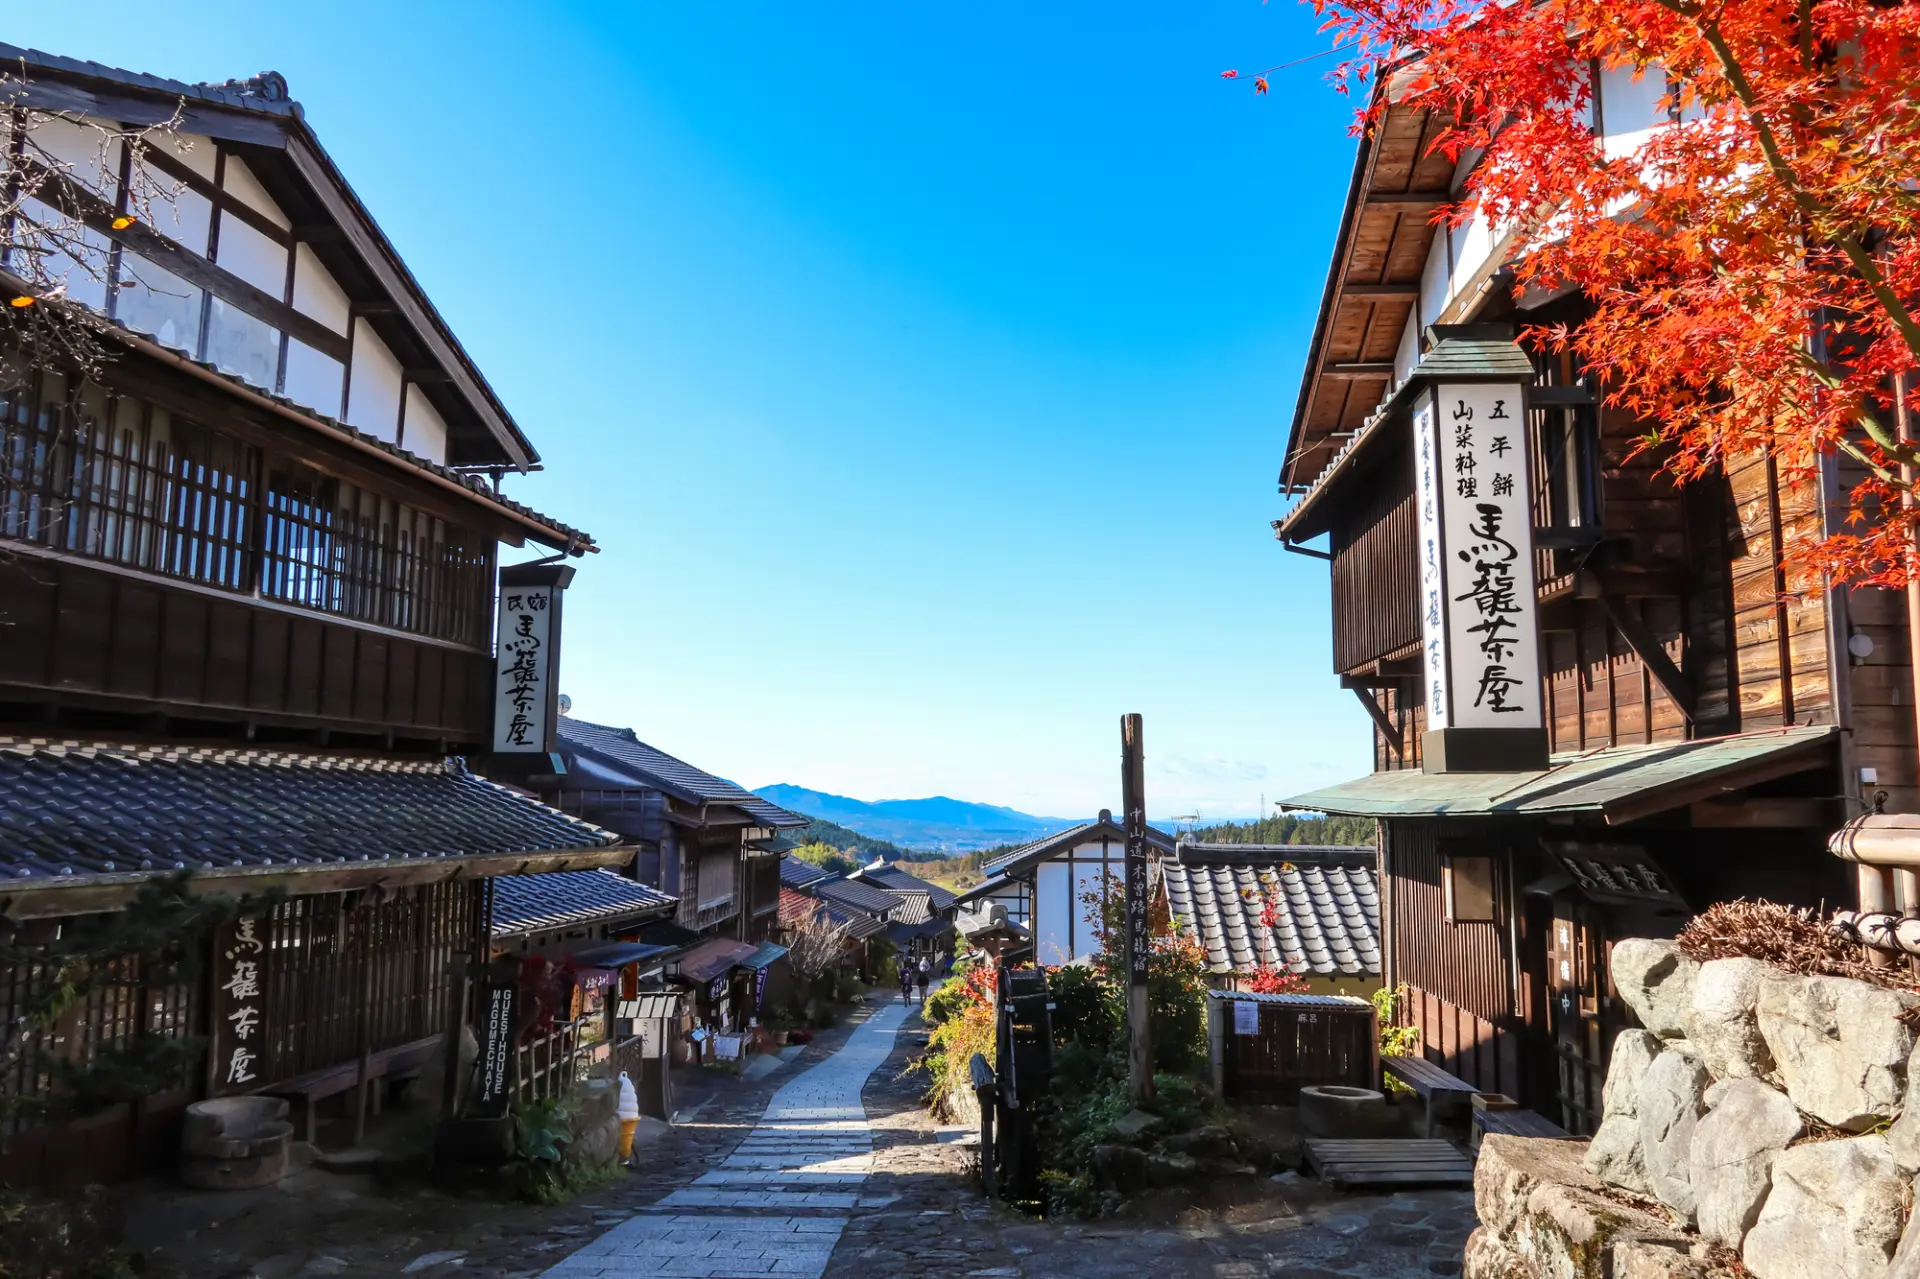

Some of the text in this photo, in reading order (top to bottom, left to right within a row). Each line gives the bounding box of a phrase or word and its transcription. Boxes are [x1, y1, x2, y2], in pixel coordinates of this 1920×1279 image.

[1453, 400, 1478, 498] 山菜料理
[1488, 400, 1514, 497] 五平餅
[507, 593, 548, 612] 民宿
[1454, 503, 1524, 713] 馬籠茶屋
[501, 614, 541, 746] 馬籠茶屋
[221, 916, 264, 1083] 馬籠茶屋
[1559, 927, 1571, 1015] 準備中
[482, 989, 501, 1101] MAGOMECHAYA
